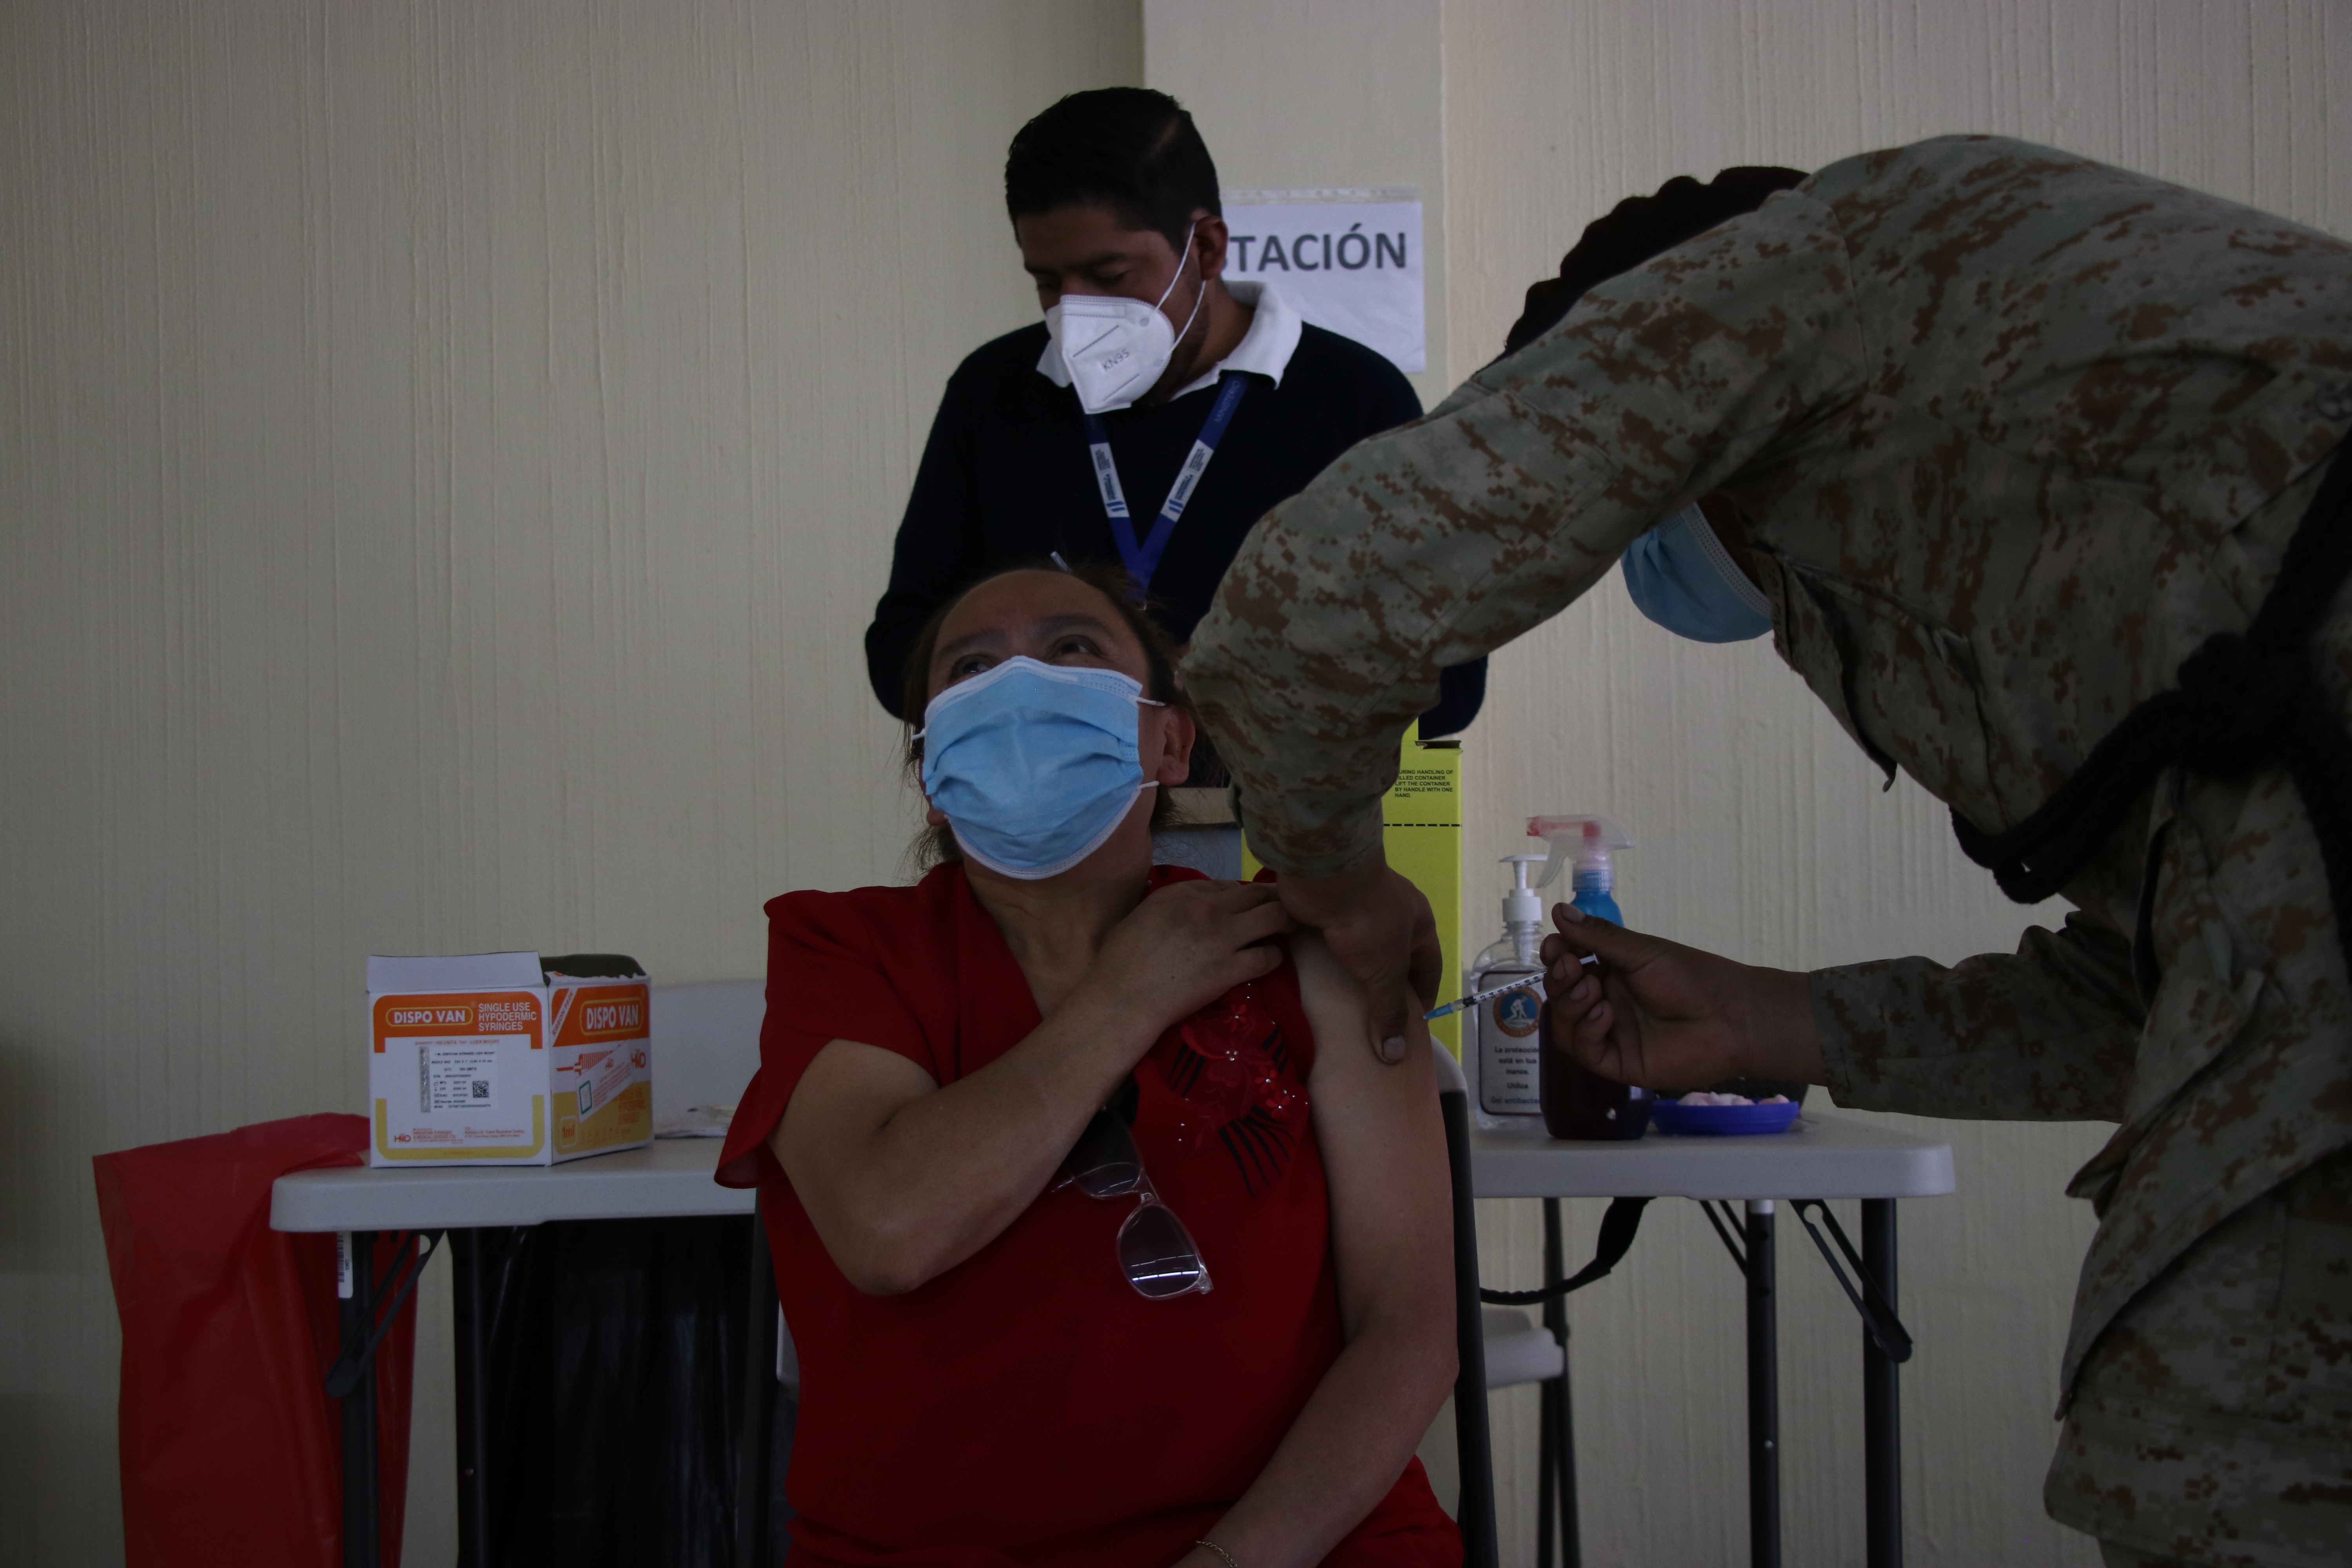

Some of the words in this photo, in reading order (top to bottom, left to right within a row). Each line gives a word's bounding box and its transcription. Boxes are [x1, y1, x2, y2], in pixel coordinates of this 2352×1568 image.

[1221, 222, 1406, 272] TACIÓN
[1102, 348, 1130, 371] KN95
[478, 1002, 510, 1012] SINGLE
[512, 1002, 531, 1011] USE
[394, 1011, 433, 1024] DISPO
[436, 1010, 465, 1022] VAN
[478, 1011, 537, 1022] HYPODERMIC
[586, 1005, 617, 1029] DISPO
[619, 1004, 639, 1026] VAN
[478, 1022, 523, 1031] SYRINGES
[562, 1124, 575, 1138] 1ml
